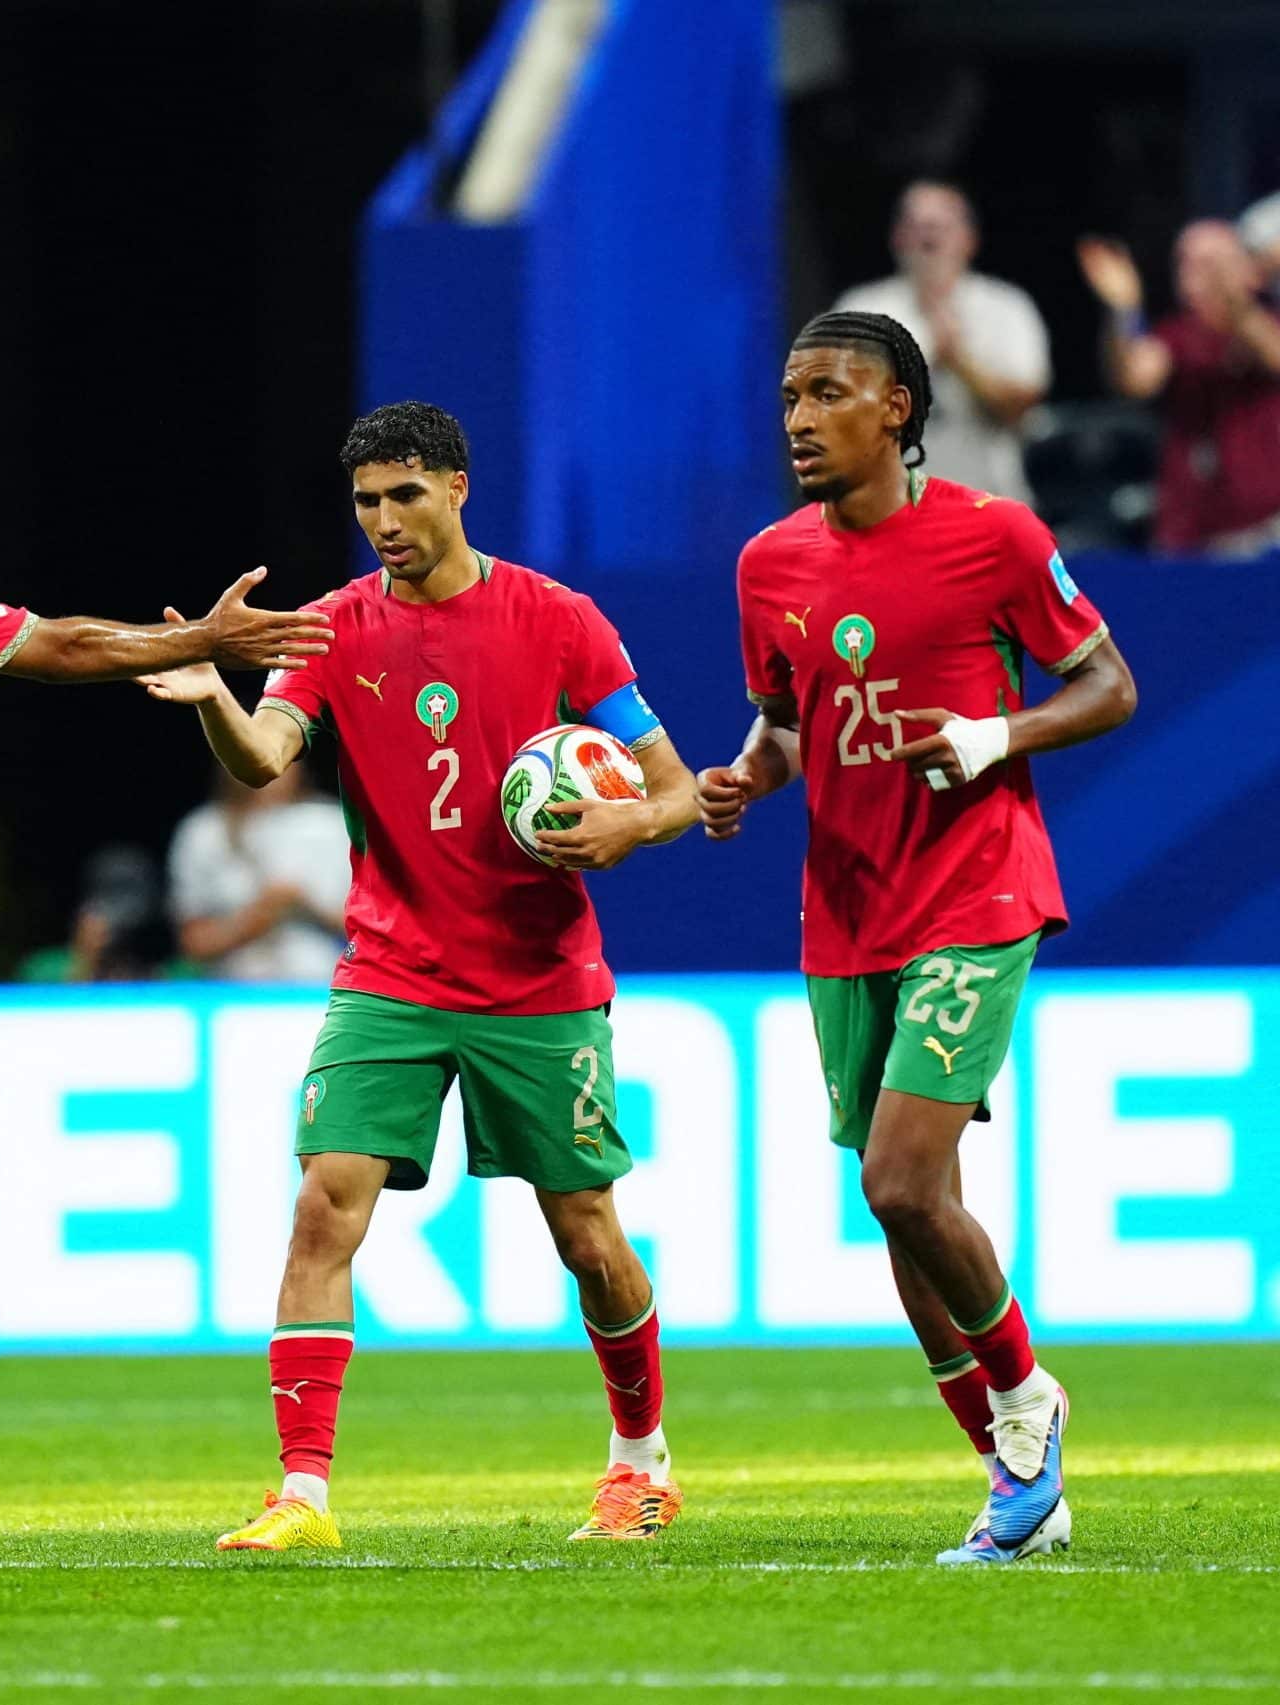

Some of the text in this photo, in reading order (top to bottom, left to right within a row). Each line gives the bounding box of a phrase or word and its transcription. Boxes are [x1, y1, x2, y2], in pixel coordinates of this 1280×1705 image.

[833, 678, 904, 767] 25
[427, 747, 462, 831] 2
[903, 956, 998, 1036] 25
[571, 1045, 604, 1130] 2
